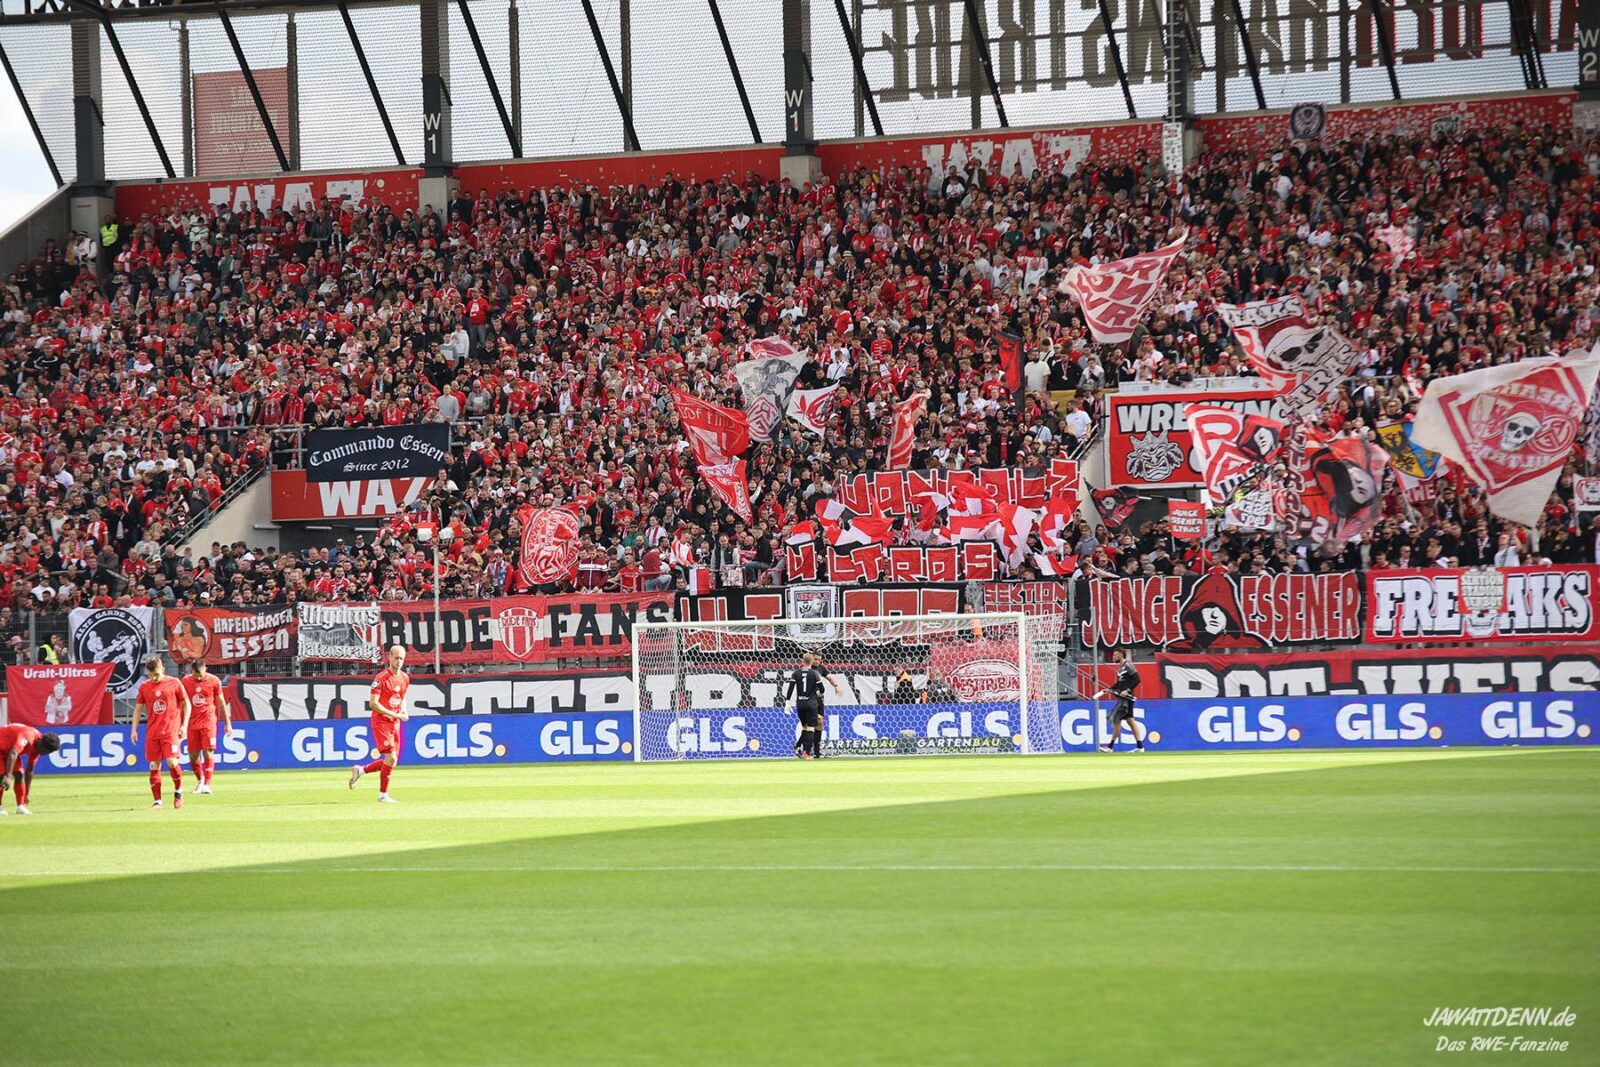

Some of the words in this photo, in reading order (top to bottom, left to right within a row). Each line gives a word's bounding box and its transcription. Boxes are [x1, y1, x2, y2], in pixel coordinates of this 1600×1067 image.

[1582, 52, 1597, 74] 2
[785, 89, 803, 108] W
[424, 113, 441, 130] W
[790, 111, 799, 132] 1
[429, 134, 437, 153] 1
[309, 435, 395, 467] Commando
[400, 434, 445, 462] Essen
[343, 461, 377, 473] Since
[381, 457, 409, 471] 2012
[785, 540, 996, 584] ULTRAS
[983, 581, 1067, 604] SEKTION
[1081, 575, 1185, 648] JUNGE
[1240, 570, 1362, 643] ESSENER
[1374, 572, 1592, 636] FREAKS
[381, 607, 494, 653] RUDE
[548, 601, 671, 650] FANS
[220, 628, 290, 659] ESSEN
[23, 668, 98, 679] Uralt-Ultras
[802, 677, 808, 693] 1
[917, 737, 1001, 748] GARTENBAU
